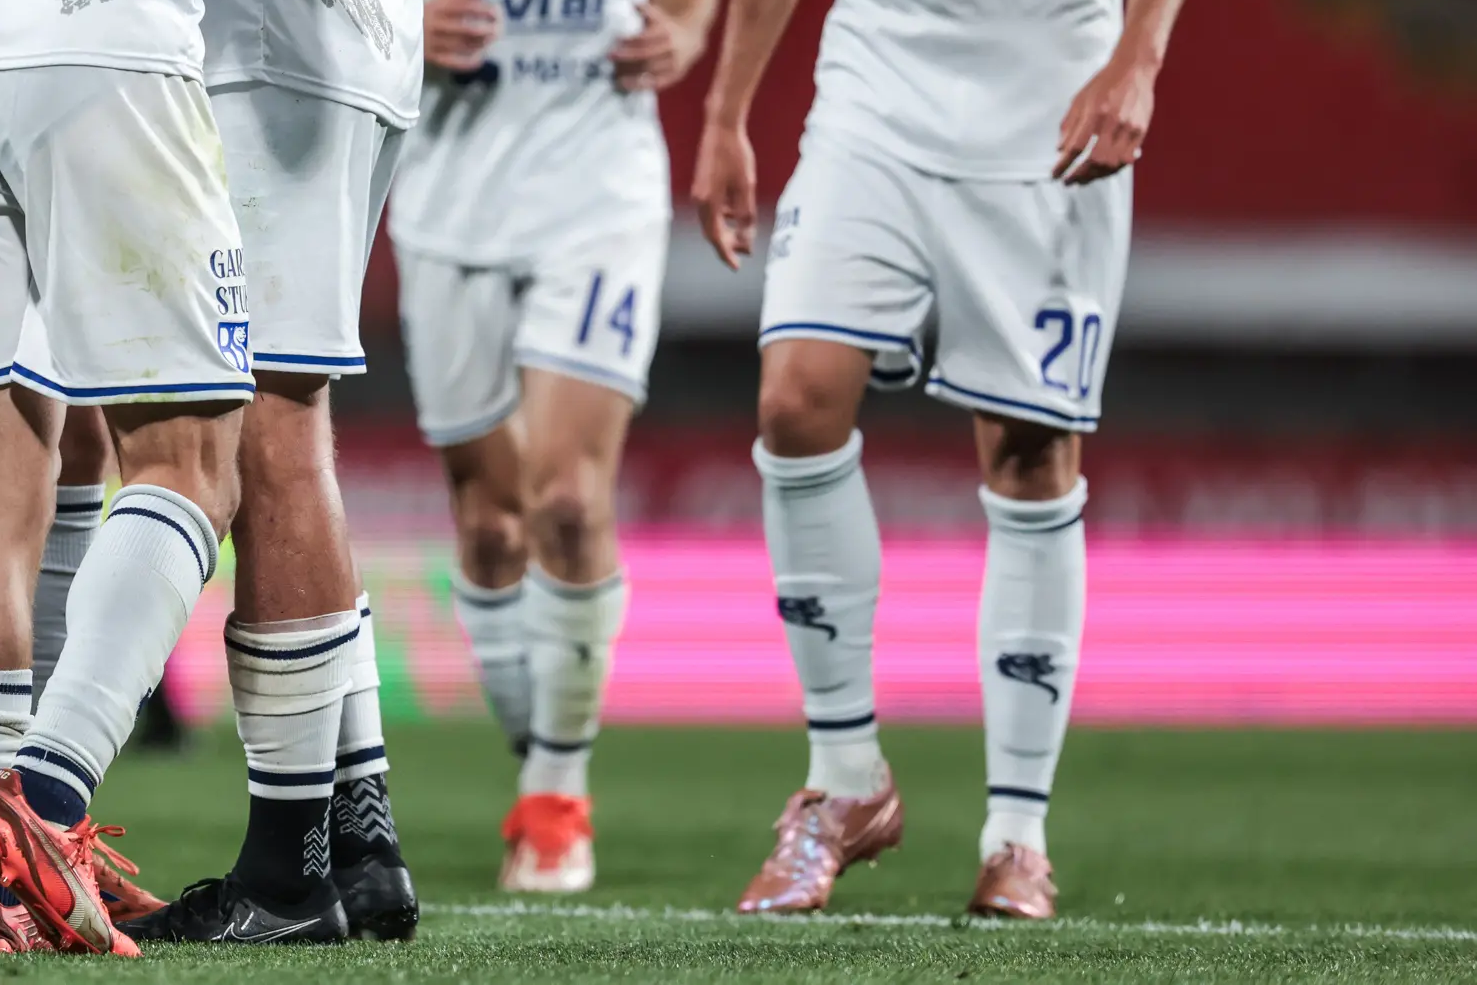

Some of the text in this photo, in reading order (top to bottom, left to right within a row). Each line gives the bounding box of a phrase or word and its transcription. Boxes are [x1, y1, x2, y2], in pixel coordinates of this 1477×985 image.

[209, 248, 245, 279] GAR
[215, 285, 249, 315] STU
[577, 270, 635, 356] 14
[1035, 309, 1101, 398] 20
